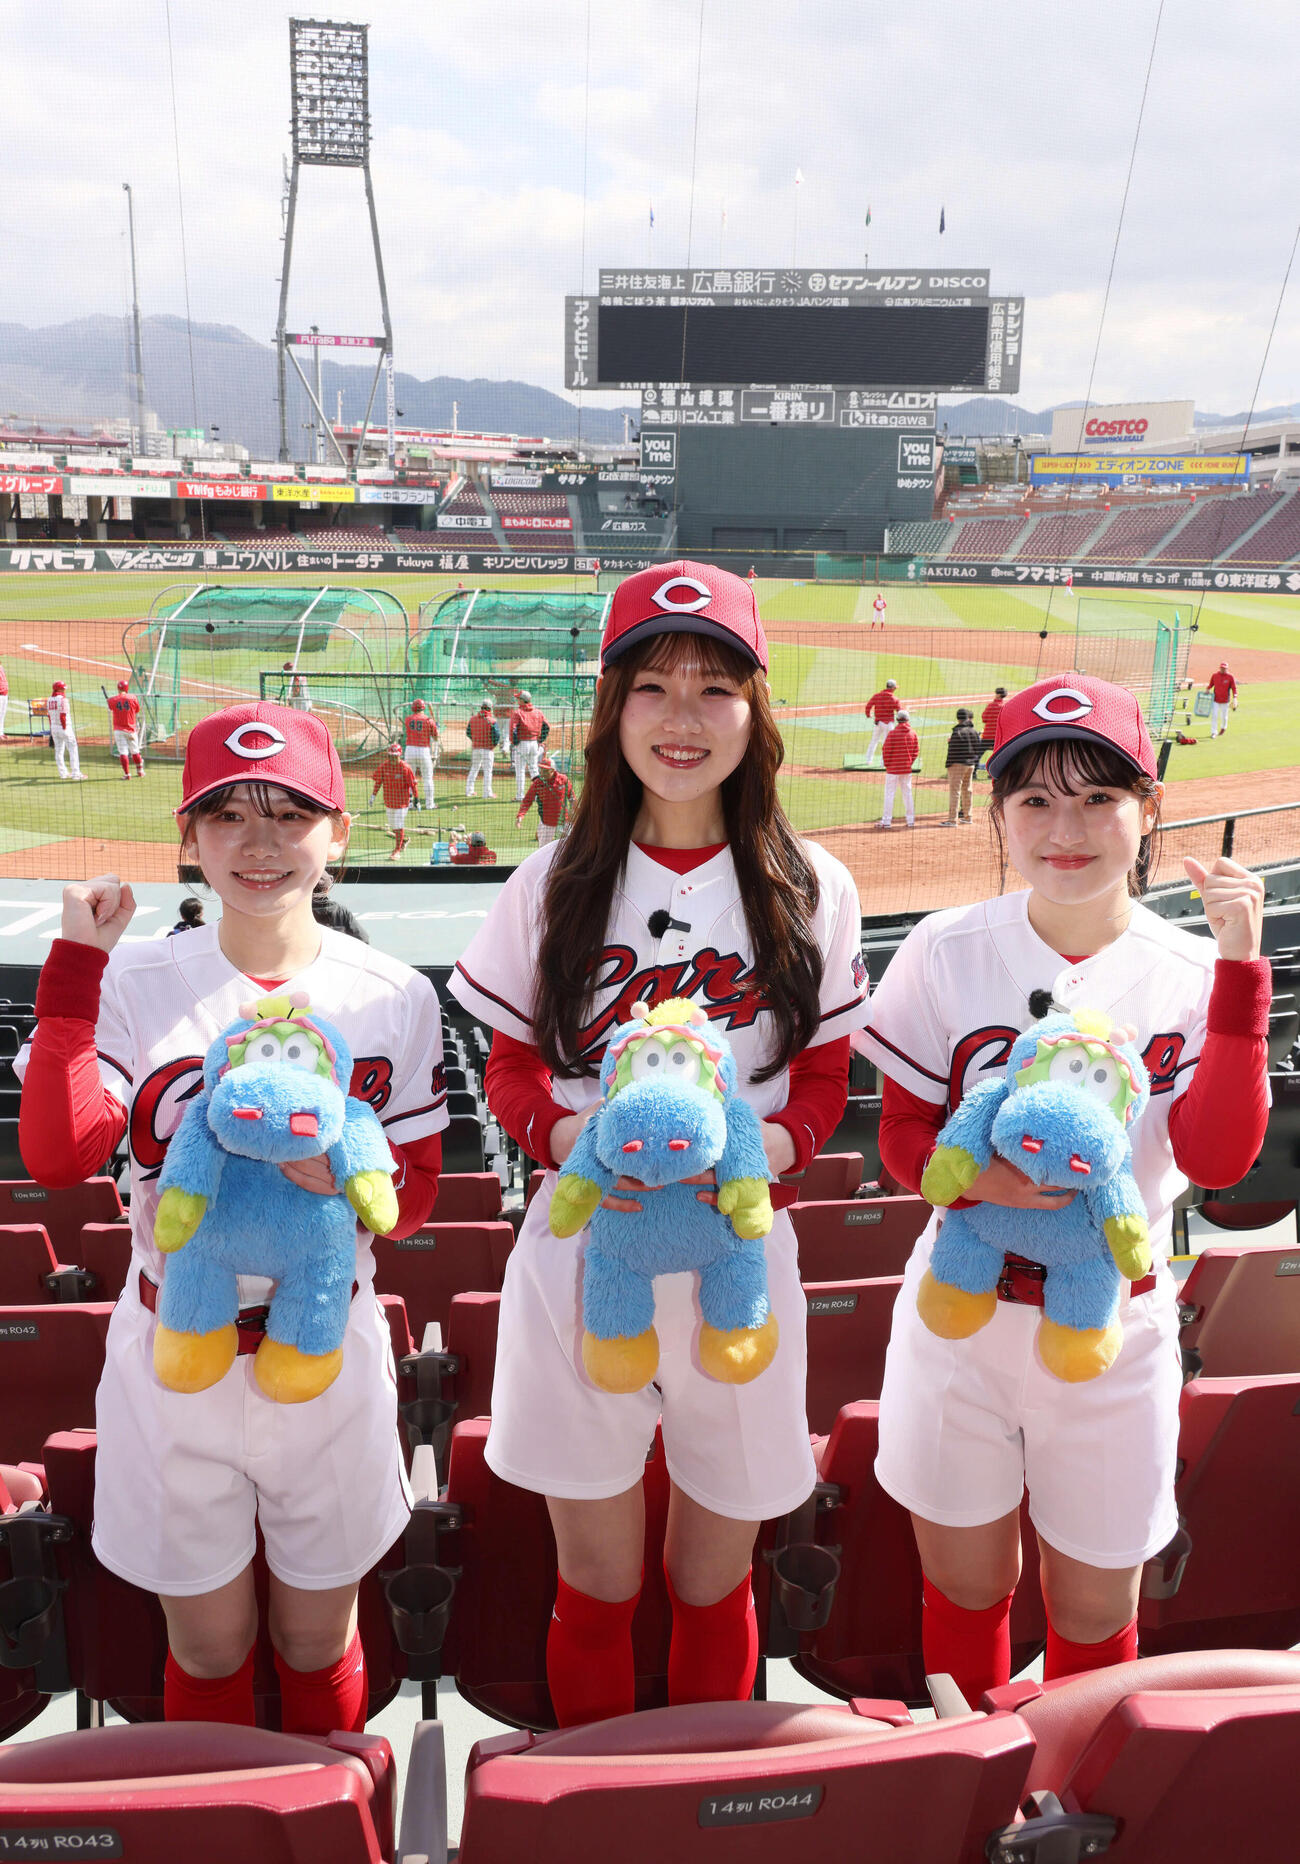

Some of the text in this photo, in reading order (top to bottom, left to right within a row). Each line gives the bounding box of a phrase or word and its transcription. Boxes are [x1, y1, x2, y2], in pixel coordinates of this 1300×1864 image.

[601, 275, 686, 290] 三井住友海上
[691, 270, 776, 293] 広島銀行
[929, 277, 987, 288] DISCO
[797, 297, 849, 306] JAバンク広島
[894, 298, 971, 307] 広島アルミニウム工業
[572, 301, 589, 386] アサヒビール
[988, 303, 1005, 390] 広島市信用組合
[661, 390, 734, 407] 福山通運
[774, 392, 802, 401] KIRIN
[888, 392, 937, 408] ムロオ
[660, 410, 735, 424] 西川ゴム工業
[750, 401, 825, 420] 一番搾り
[849, 410, 927, 425] Kitagawa
[1085, 418, 1148, 436] COSTCO
[1104, 435, 1144, 443] WHOLESALE
[644, 440, 671, 453] you
[903, 443, 930, 456] you
[649, 451, 672, 462] me
[907, 455, 931, 465] me
[1095, 460, 1184, 471] エディオン ZONE
[504, 477, 538, 485] LOGICOM
[640, 474, 675, 485] ゆめタウン
[897, 478, 933, 489] ゆめタウン
[215, 485, 258, 498] もみじ銀行
[276, 489, 310, 498] 東洋水産
[383, 491, 434, 503] 中電プラント
[455, 517, 488, 527] 中電工
[612, 521, 647, 531] 広島ガス
[9, 550, 95, 570] クマヒラ
[221, 551, 292, 570] ユウベル
[397, 555, 469, 570] Fukuya 福屋
[483, 557, 569, 570] キリンビバレッジ
[920, 567, 977, 577] SAKURAO
[1015, 567, 1083, 582] フマキラー
[1091, 571, 1139, 583] 中国新聞
[1228, 573, 1281, 589] 東洋証券
[116, 700, 130, 711] 44
[811, 1301, 829, 1310] 12列
[710, 1801, 753, 1815] 14列
